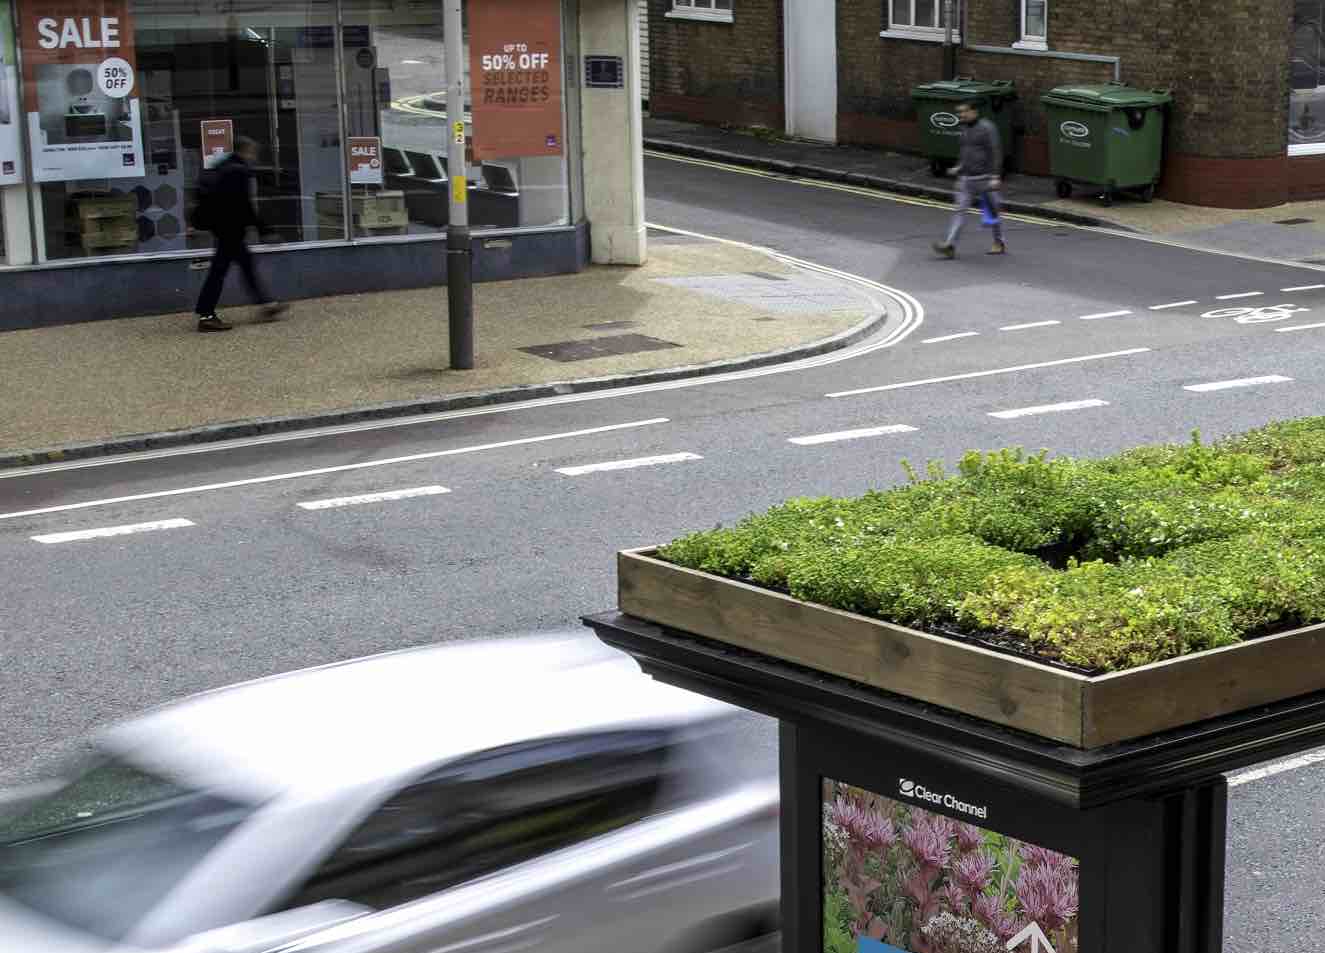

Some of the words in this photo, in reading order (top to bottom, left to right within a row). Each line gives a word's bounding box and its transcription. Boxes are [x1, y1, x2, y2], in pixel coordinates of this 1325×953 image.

[38, 17, 121, 49] SALE
[503, 43, 515, 53] UP
[516, 43, 528, 52] TO
[482, 54, 516, 70] 50%
[519, 53, 549, 69] OFF
[104, 67, 127, 79] 50%
[484, 71, 550, 86] SELECTED
[106, 78, 127, 90] OFF
[484, 86, 550, 104] RANGES
[351, 146, 377, 157] SALE
[915, 785, 943, 804] Clear
[944, 794, 987, 819] Channel
